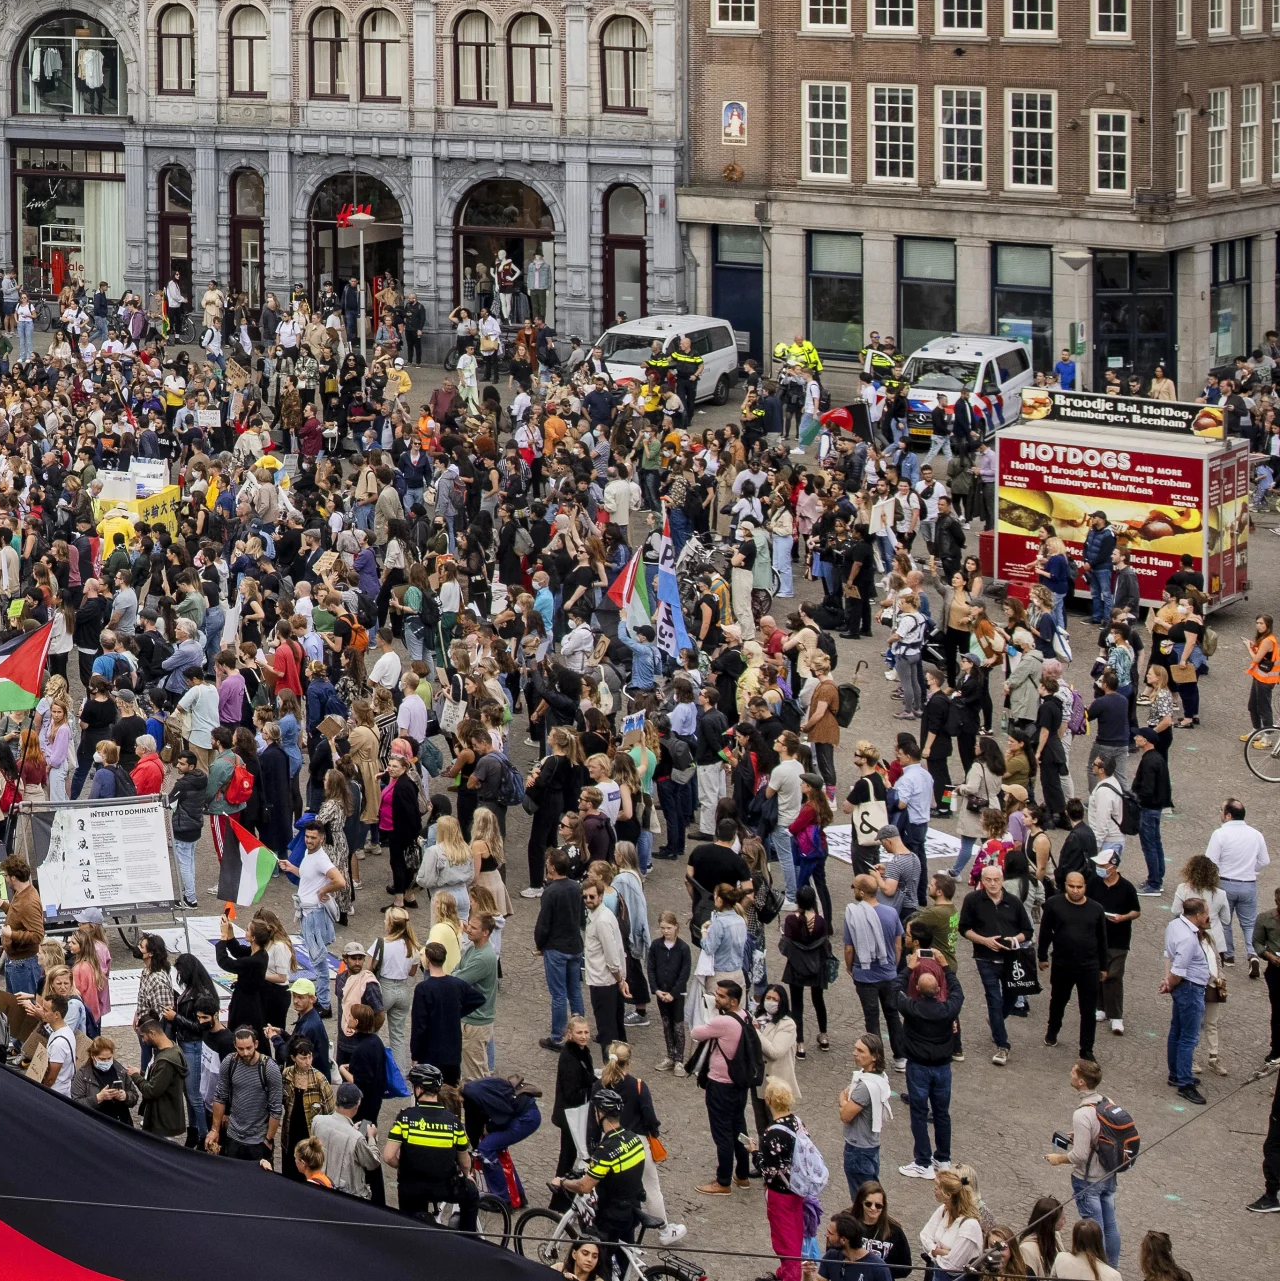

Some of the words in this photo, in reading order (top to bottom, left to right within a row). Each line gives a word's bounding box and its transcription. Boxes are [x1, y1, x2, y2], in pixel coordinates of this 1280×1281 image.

[1054, 394, 1114, 412] Broodje
[1116, 402, 1140, 414] Bal,
[1143, 405, 1193, 419] HotDog,
[1060, 407, 1129, 424] Hamburger,
[1132, 414, 1187, 429] Beenham
[1020, 442, 1131, 471] HOTDOGS
[1135, 465, 1154, 473] AND
[1157, 467, 1182, 477] MORE
[1010, 460, 1050, 474] HotDog,
[1051, 465, 1089, 478] Broodje
[1090, 469, 1109, 481] Bal,
[1111, 472, 1145, 484] Warme
[1146, 475, 1191, 489] Beenham
[1014, 475, 1029, 483] COLD
[1043, 474, 1101, 490] Hamburger,
[1102, 481, 1154, 496] Ham/Kaas
[1170, 493, 1183, 501] ICE
[1173, 500, 1197, 509] DRINKS
[1149, 556, 1173, 568] Ham
[90, 810, 115, 819] INTENT
[124, 806, 159, 816] DOMINATE
[859, 810, 877, 836] &
[1017, 980, 1035, 988] Slegte
